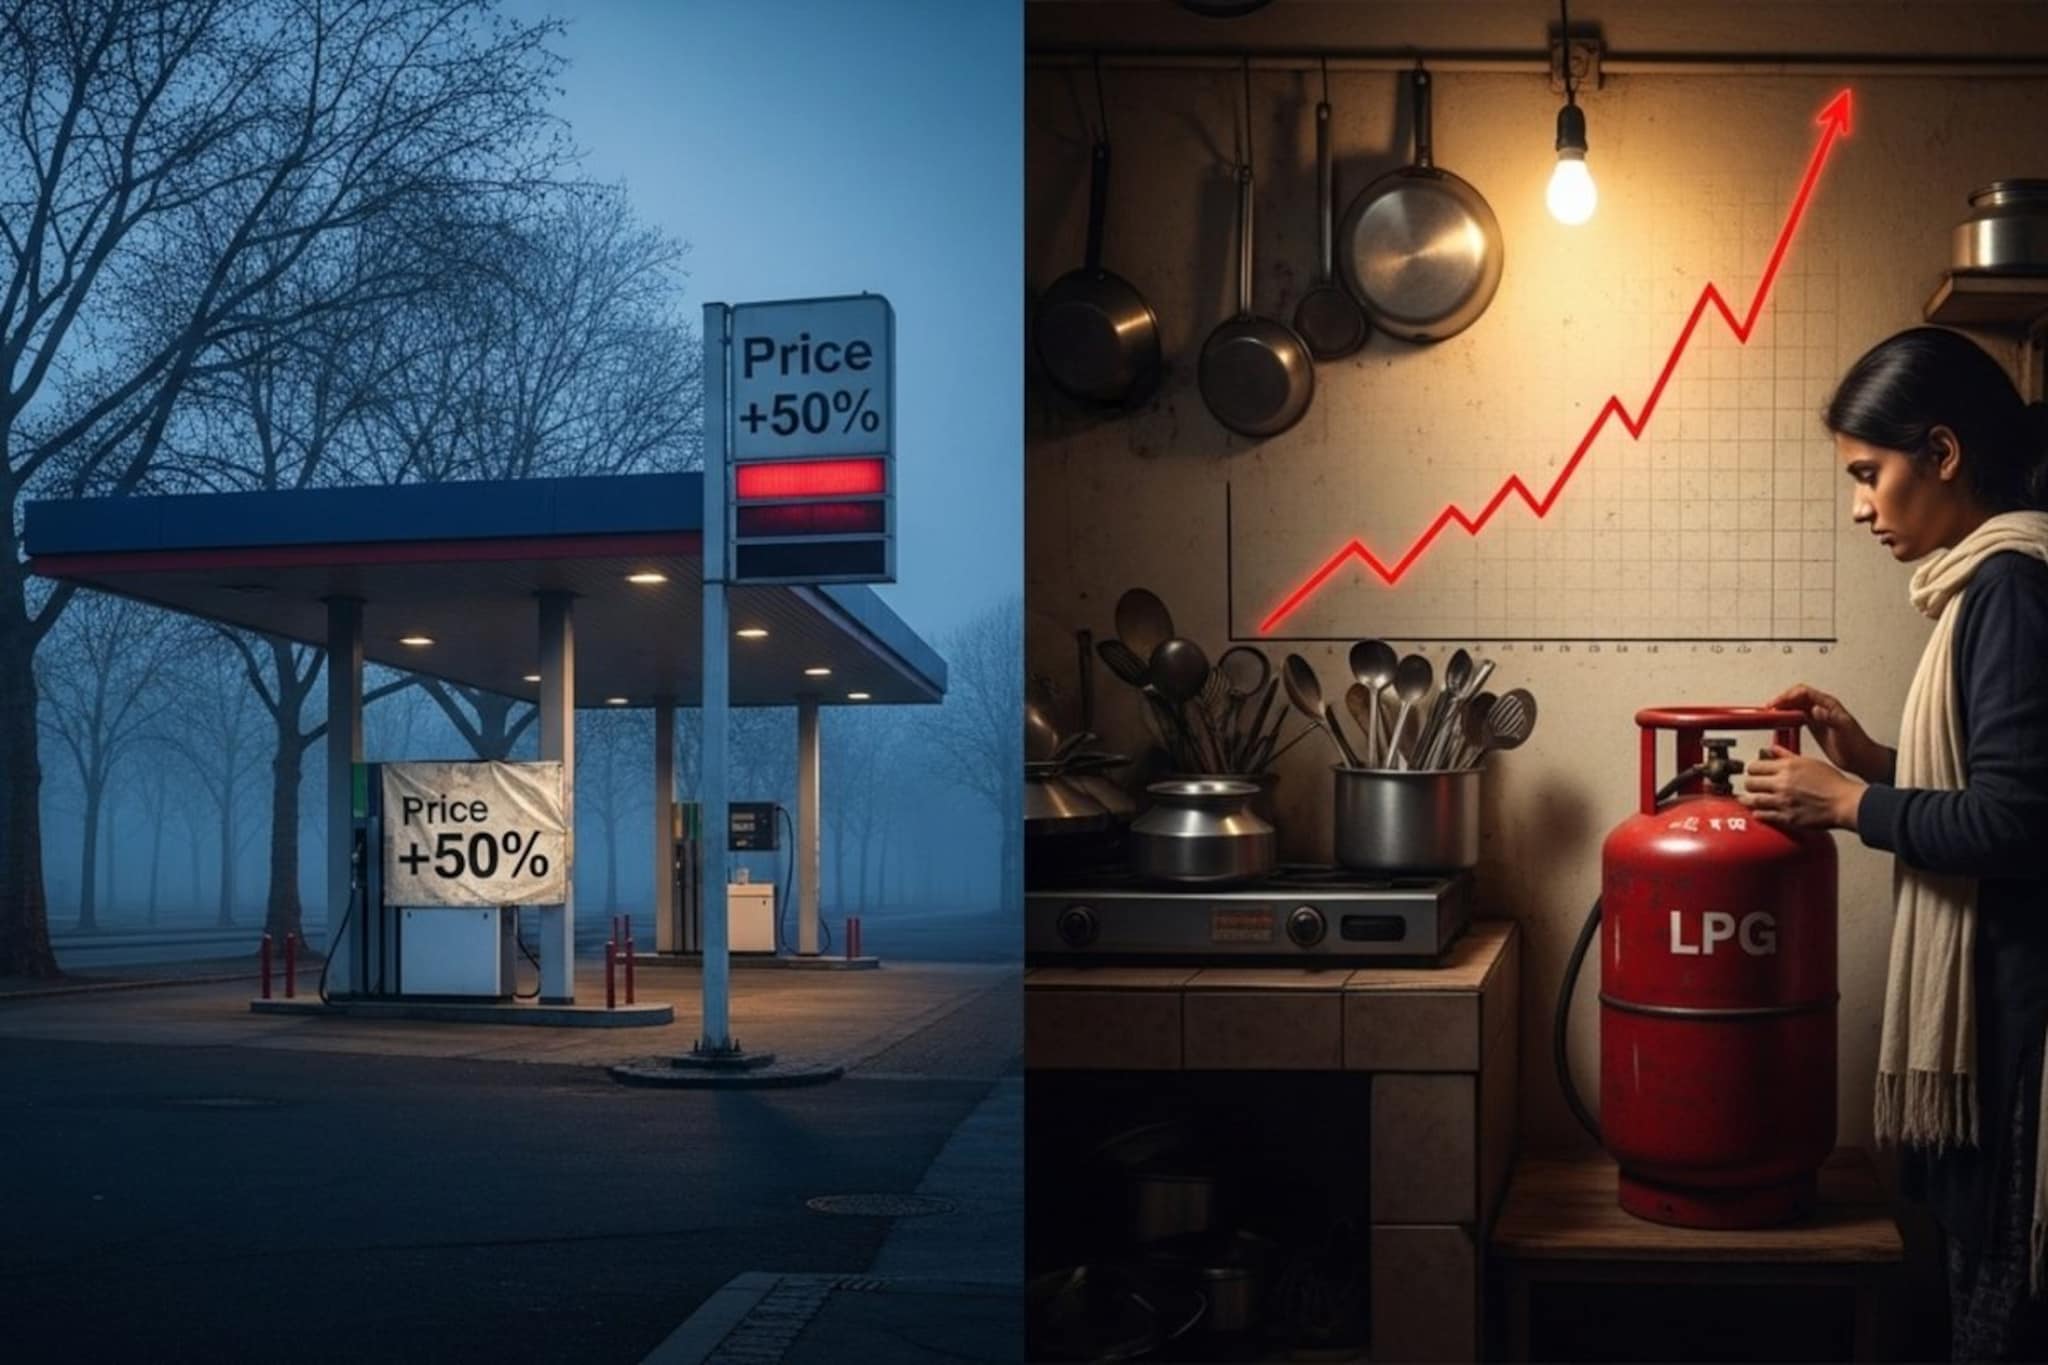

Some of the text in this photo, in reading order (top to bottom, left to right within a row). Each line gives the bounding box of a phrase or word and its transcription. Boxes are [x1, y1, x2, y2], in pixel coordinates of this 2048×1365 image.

[743, 333, 873, 378] Price
[739, 389, 880, 436] +50%
[402, 794, 488, 826] Price
[399, 830, 550, 879] +50%
[1670, 910, 1777, 955] LPG
